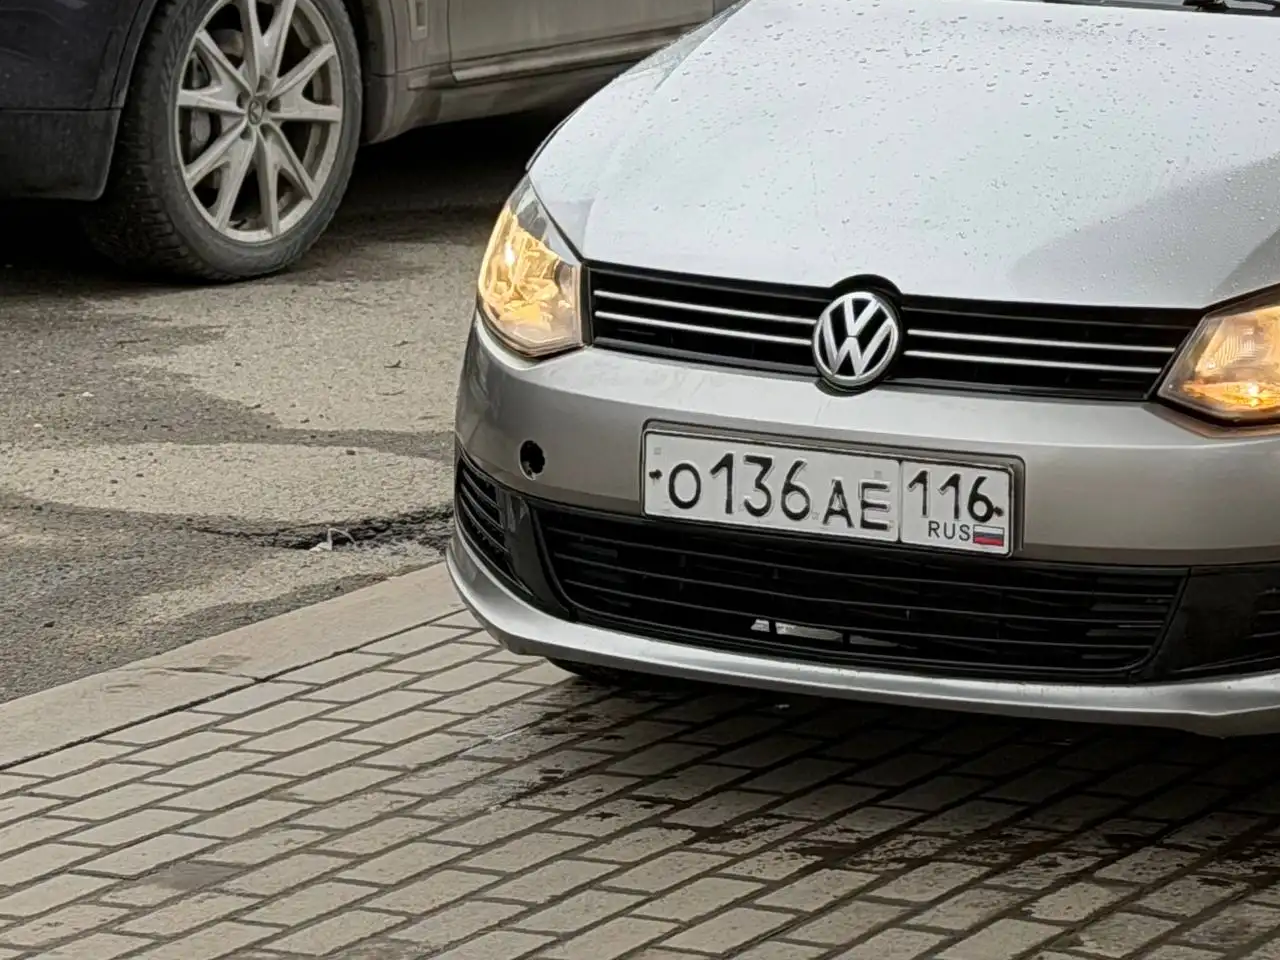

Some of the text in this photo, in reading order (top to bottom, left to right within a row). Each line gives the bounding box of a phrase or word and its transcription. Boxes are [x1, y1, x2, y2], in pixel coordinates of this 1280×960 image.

[819, 295, 895, 378] VW
[907, 470, 994, 523] 116
[928, 520, 971, 541] RUS
